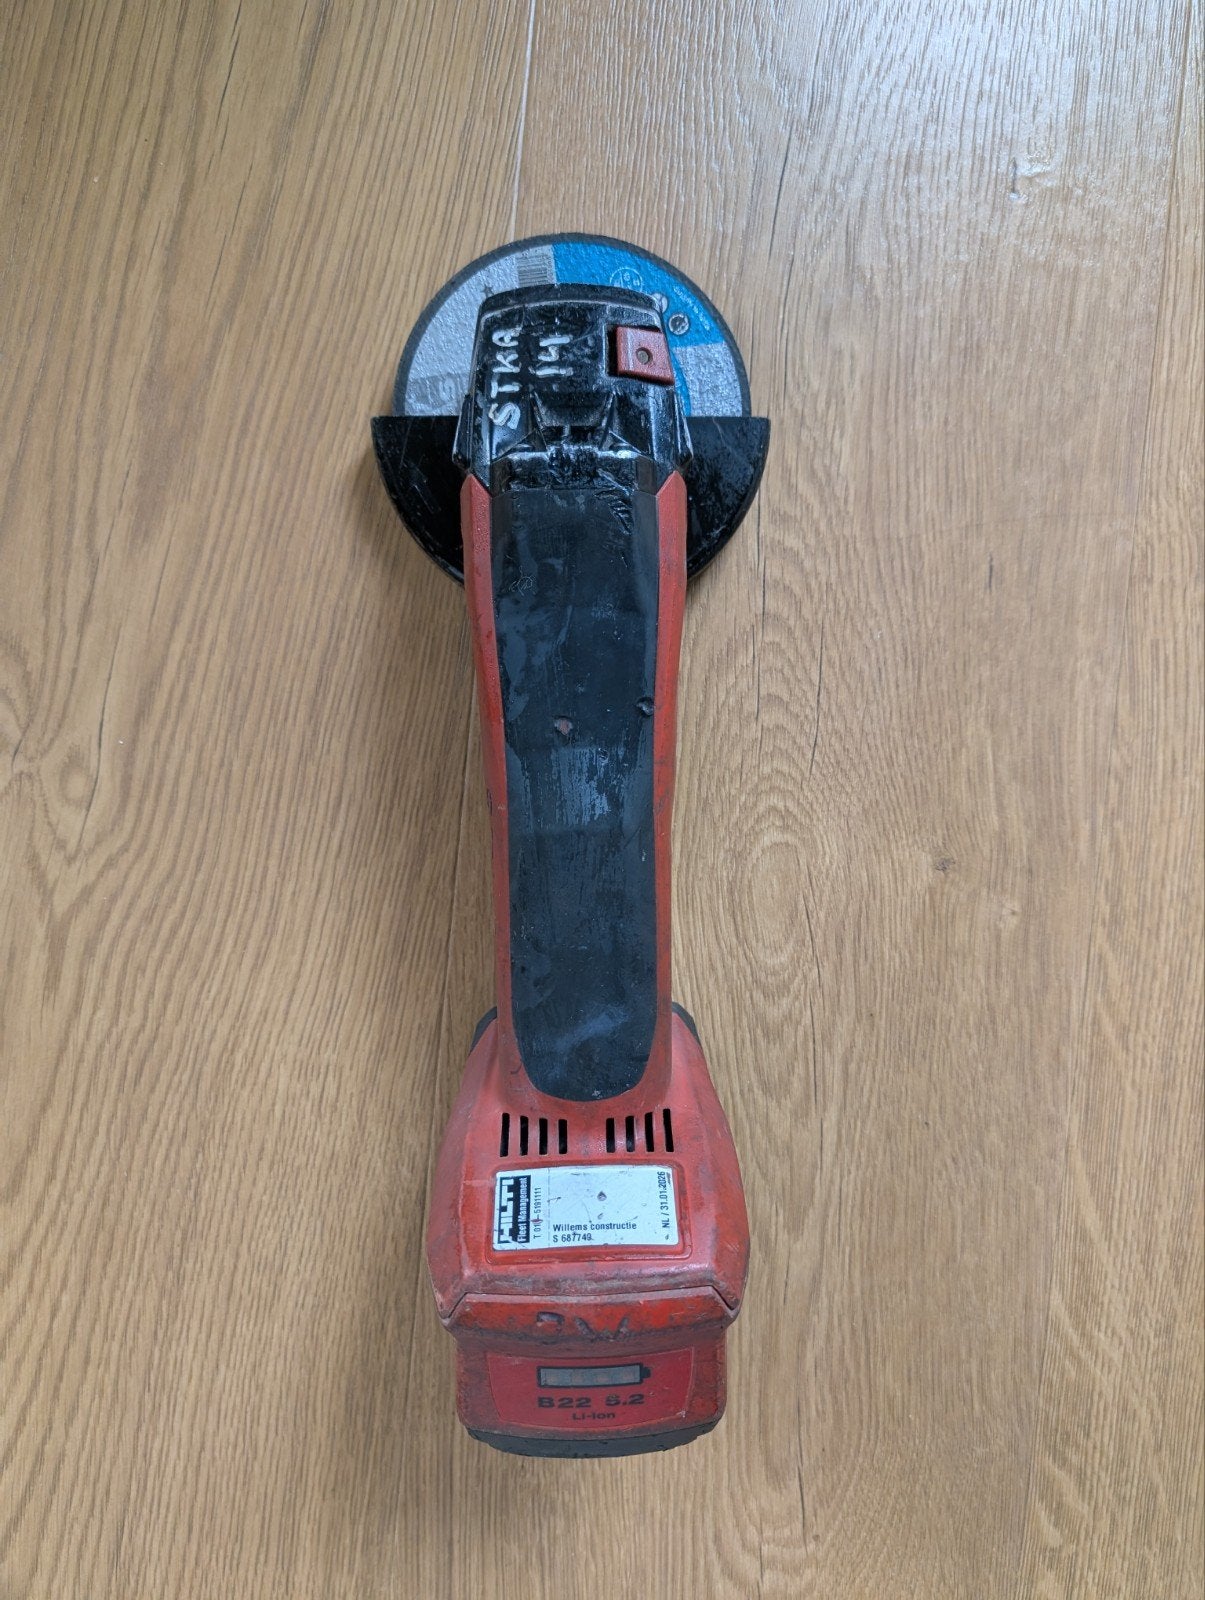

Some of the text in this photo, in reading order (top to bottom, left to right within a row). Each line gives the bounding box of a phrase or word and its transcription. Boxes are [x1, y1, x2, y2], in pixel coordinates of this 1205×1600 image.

[488, 325, 523, 430] STKA
[500, 1178, 514, 1241] HILTI
[517, 1177, 529, 1242] Fleet Management
[533, 1187, 543, 1232] 01-5191111
[657, 1171, 669, 1211] 31.01.2026
[552, 1232, 593, 1242] S 687749
[553, 1222, 638, 1232] Willems constructie
[662, 1218, 670, 1228] NL
[538, 1394, 645, 1408] B22 5.2
